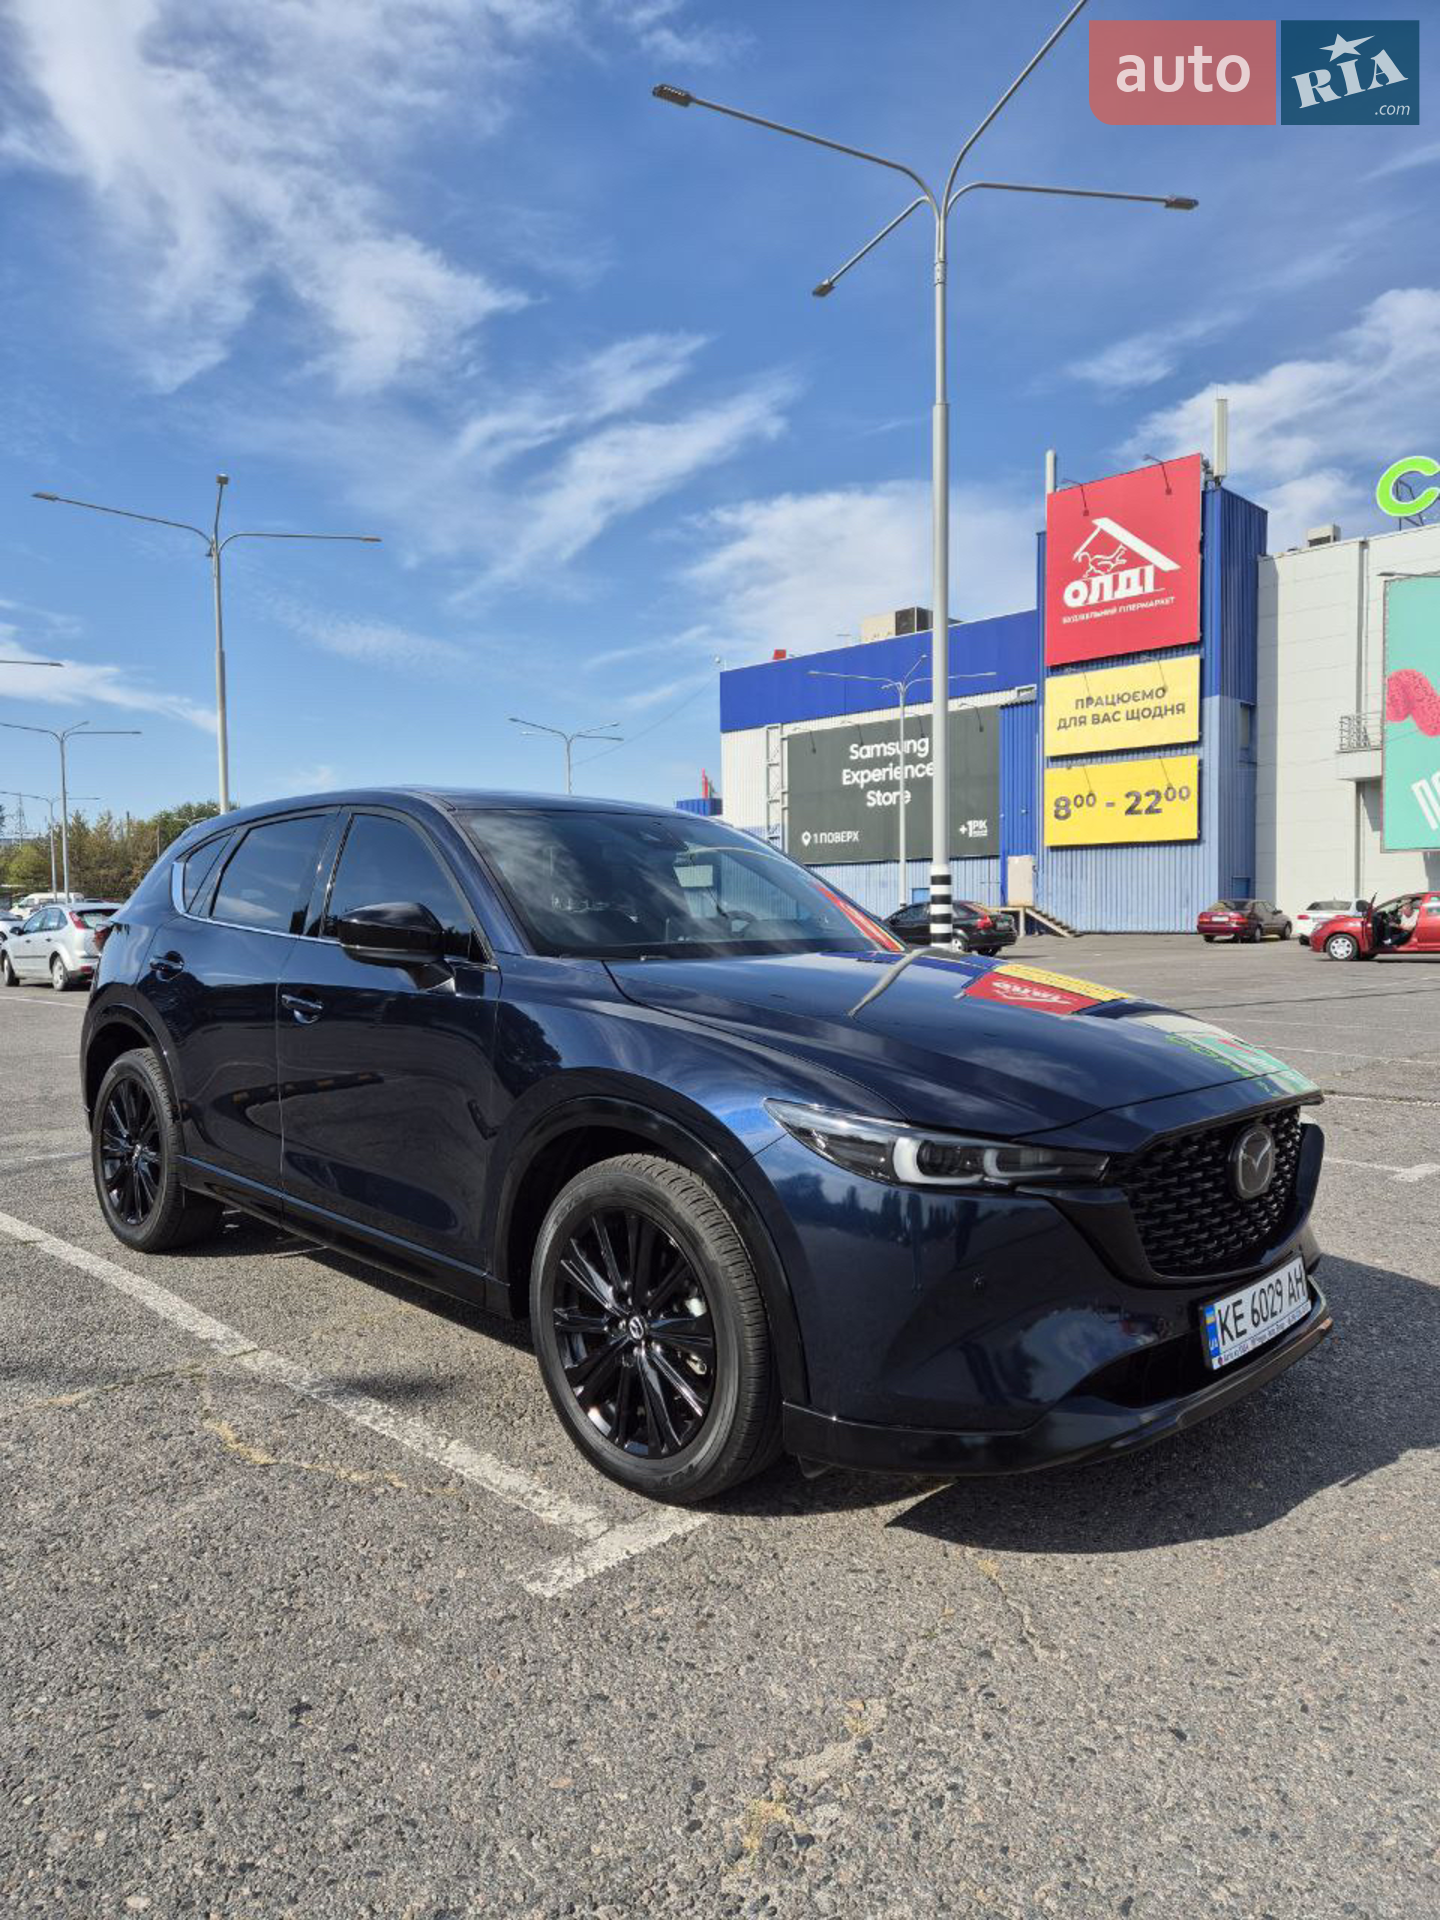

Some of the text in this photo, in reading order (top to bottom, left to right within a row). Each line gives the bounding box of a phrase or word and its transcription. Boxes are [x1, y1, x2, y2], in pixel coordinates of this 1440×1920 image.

[1075, 686, 1167, 710] ПРАЦЮЄМО
[1057, 702, 1186, 731] ДЛЯ ВАС ЩОДНЯ
[849, 737, 929, 760] Samsung
[842, 762, 934, 789] Experience
[820, 831, 859, 843] ПОВЕРХ
[1218, 1298, 1247, 1346] KE
[1250, 1278, 1284, 1328] 6029
[1287, 1264, 1306, 1307] AH
